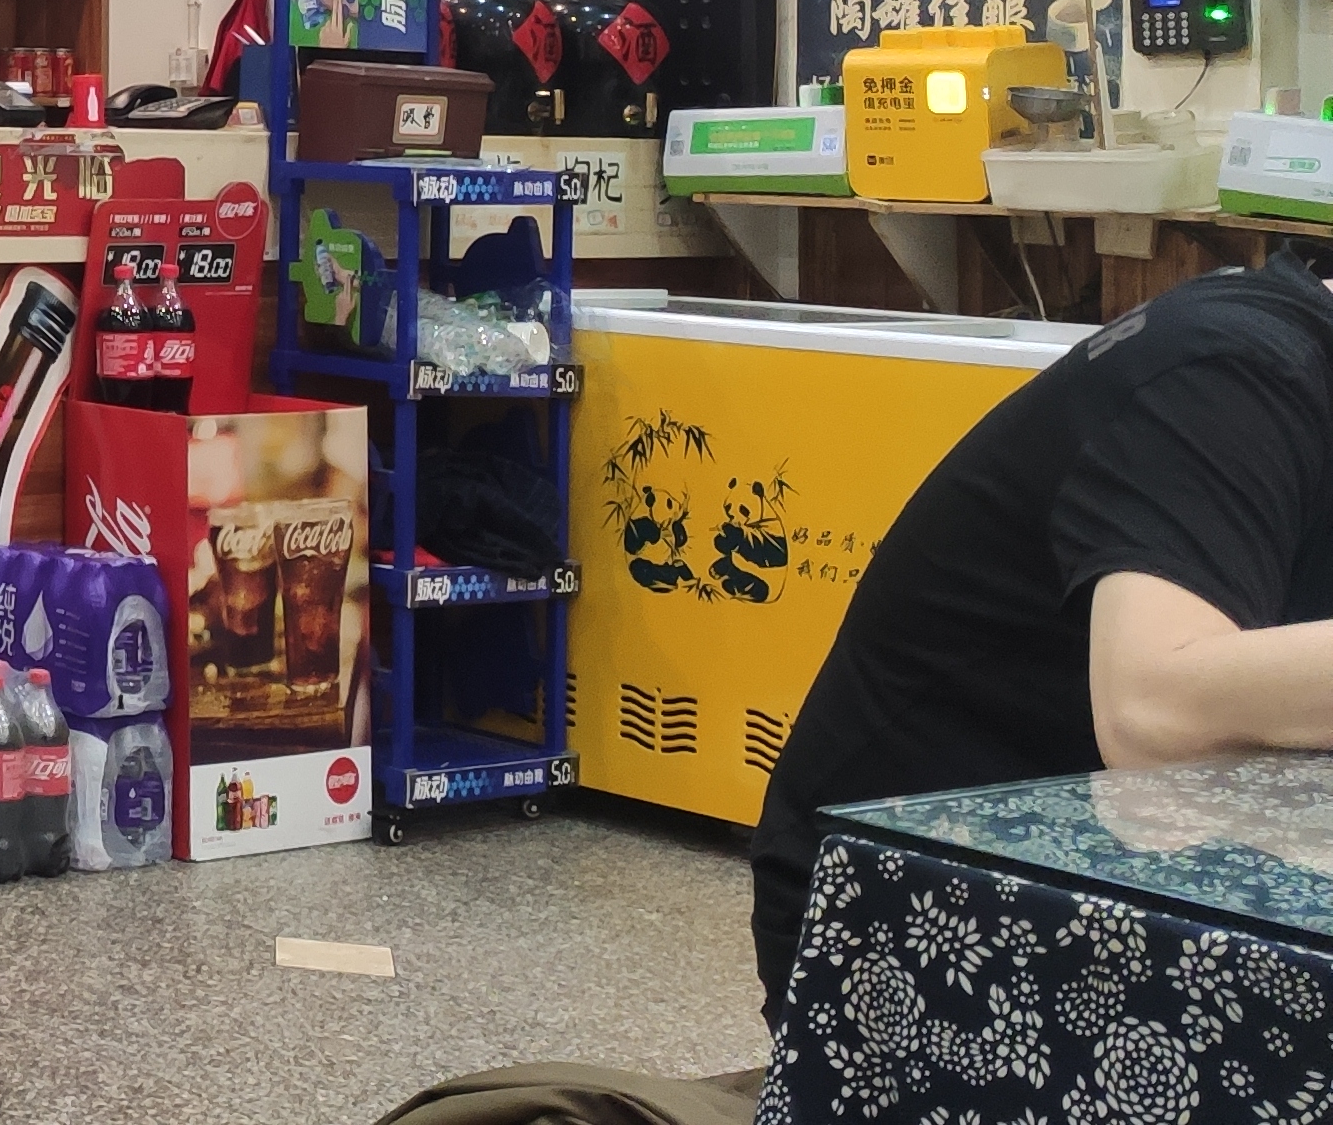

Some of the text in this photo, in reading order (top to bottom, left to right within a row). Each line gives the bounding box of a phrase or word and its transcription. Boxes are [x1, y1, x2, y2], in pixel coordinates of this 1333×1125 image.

[617, 17, 658, 66] 酒
[862, 75, 916, 95] 免押金
[418, 175, 458, 204] 脉动
[189, 248, 233, 278] 18.00
[415, 365, 453, 395] 脉动
[283, 513, 353, 561] Coca-Cola
[414, 574, 452, 606] 脉动
[411, 772, 449, 805] 脉动
